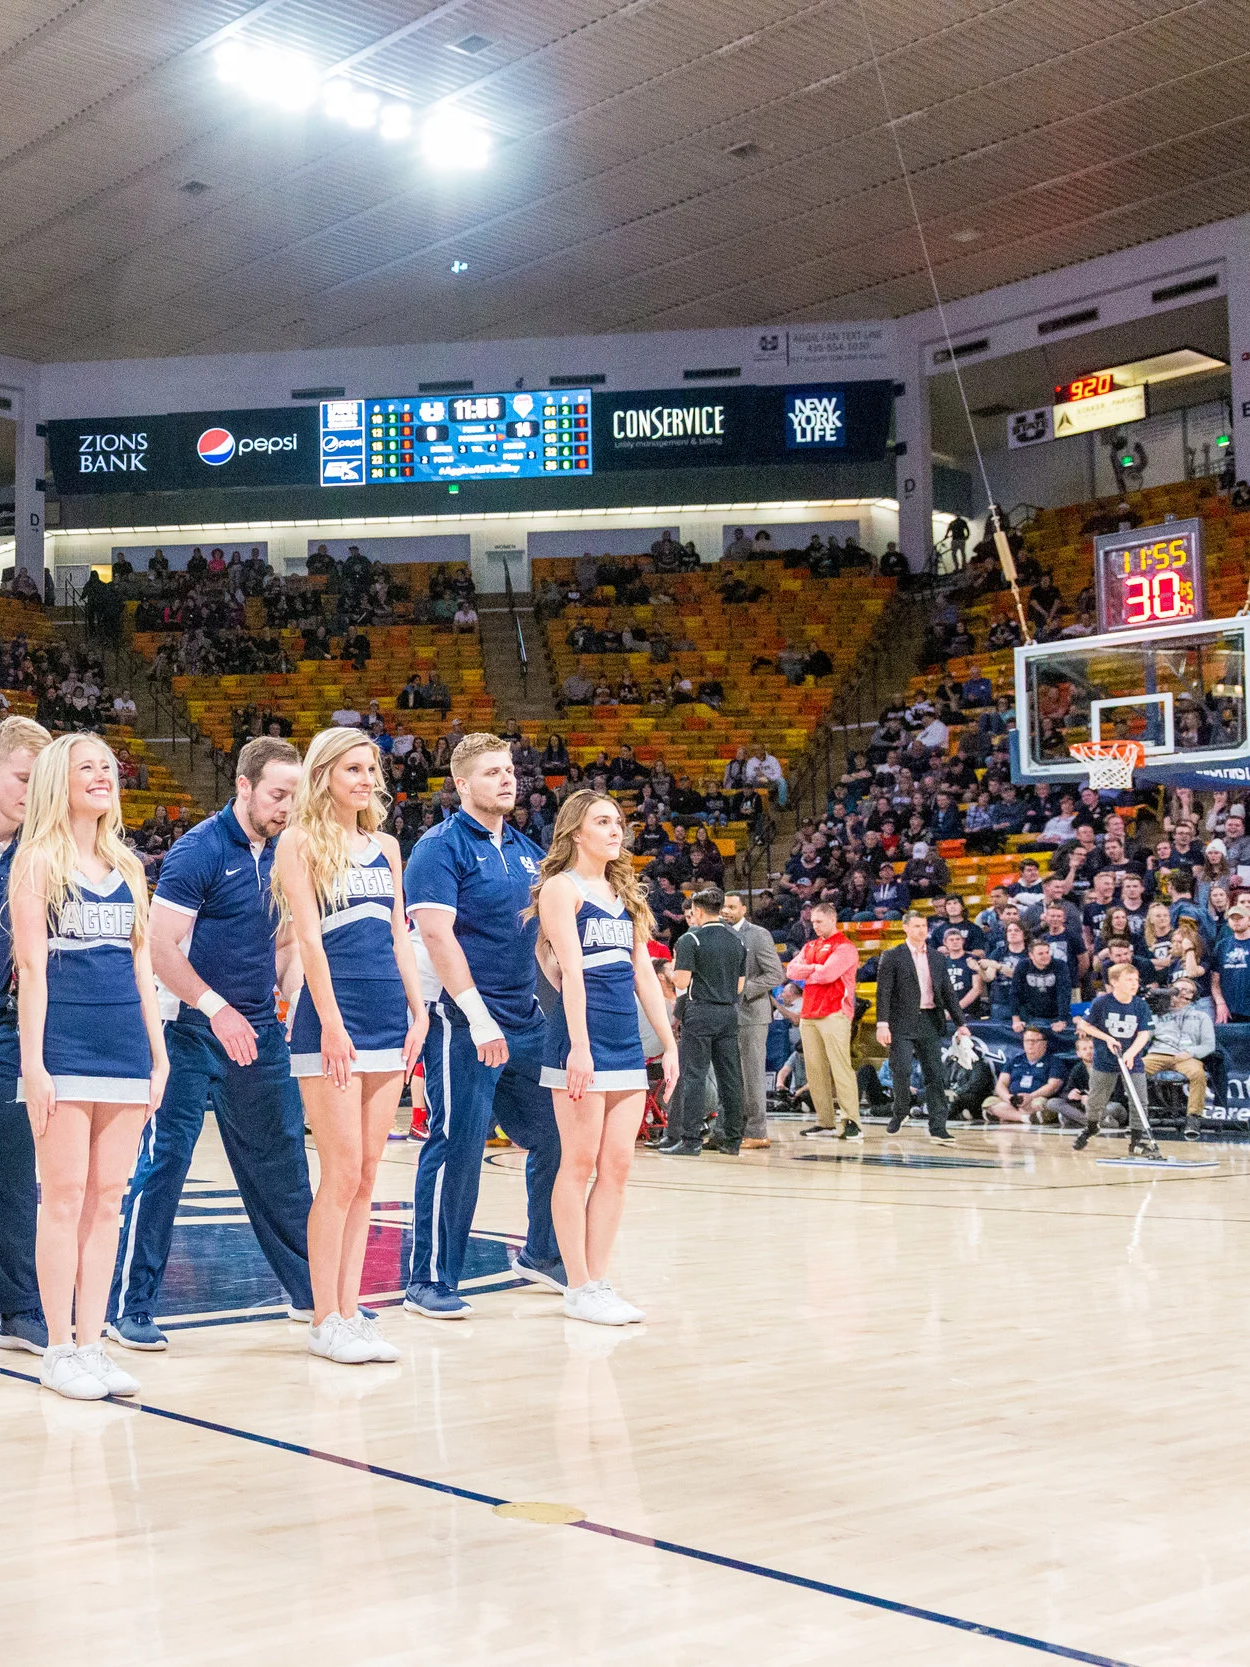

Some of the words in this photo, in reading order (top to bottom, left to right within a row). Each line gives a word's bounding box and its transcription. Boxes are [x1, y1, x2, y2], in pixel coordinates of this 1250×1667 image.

[453, 398, 500, 421] 11:55
[794, 398, 837, 415] NEW
[613, 405, 725, 440] CONSERVICE
[788, 410, 843, 430] YORK
[79, 432, 149, 453] ZIONS
[238, 433, 298, 456] pepsi
[795, 426, 837, 443] LIFE
[78, 453, 148, 473] BANK
[904, 478, 916, 494] D
[30, 512, 40, 527] D
[1123, 539, 1187, 573] 11:55
[1125, 571, 1181, 624] 30
[331, 867, 395, 899] AGGIE
[58, 901, 135, 938] AGGIE
[582, 918, 634, 949] AGGIE
